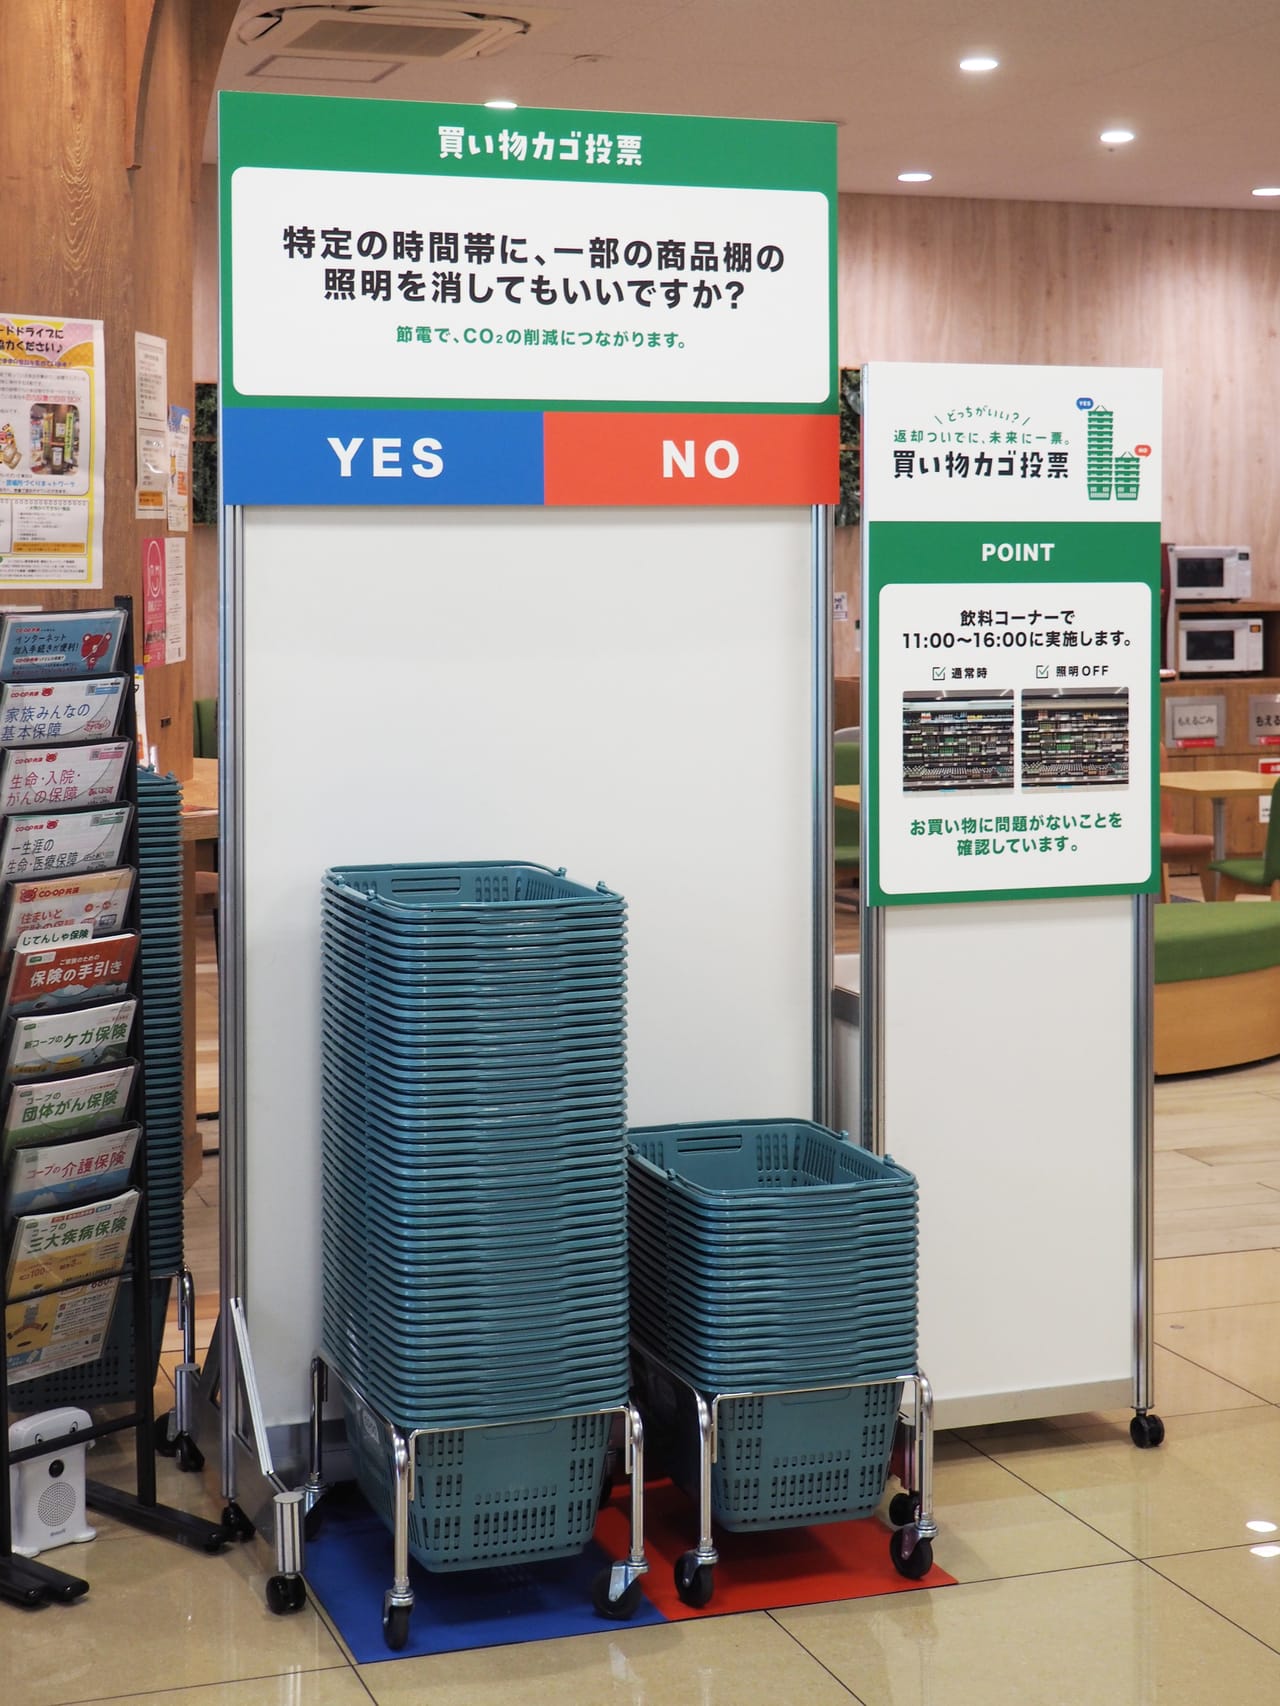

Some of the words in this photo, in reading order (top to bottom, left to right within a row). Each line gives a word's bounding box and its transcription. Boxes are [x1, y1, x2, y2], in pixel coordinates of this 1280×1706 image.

[437, 125, 644, 167] 買い物カゴ投票
[283, 225, 785, 274] 特定の時間帯に、一部の商品棚の
[323, 268, 746, 312] 照明を消してもいいですか?
[946, 404, 1021, 424] どっちがいい?
[893, 428, 1071, 446] 返却ついでに、未来に一票。
[327, 436, 445, 480] YES
[661, 439, 741, 480] NO
[893, 449, 1070, 480] 買い物カゴ投票
[981, 542, 1056, 564] POINT
[960, 609, 1076, 628] 飲料コーナーで
[951, 666, 989, 680] 通常時
[1056, 664, 1110, 679] 照明OFF
[5, 703, 91, 724] 家族みんなの
[2, 722, 62, 741] 基本保障
[6, 786, 78, 807] がんの保障
[910, 812, 1124, 837] お買い物に問題がないことを
[11, 838, 55, 856] 一生涯の
[956, 835, 1079, 858] 確認しています。
[21, 908, 63, 925] 住まいと
[22, 928, 89, 946] じてんしゃ保険
[30, 959, 123, 988] 保険の手引き
[22, 1088, 119, 1123] 団体がん保険
[26, 1091, 62, 1106] コープの
[27, 1215, 128, 1255] 三大疾病保険
